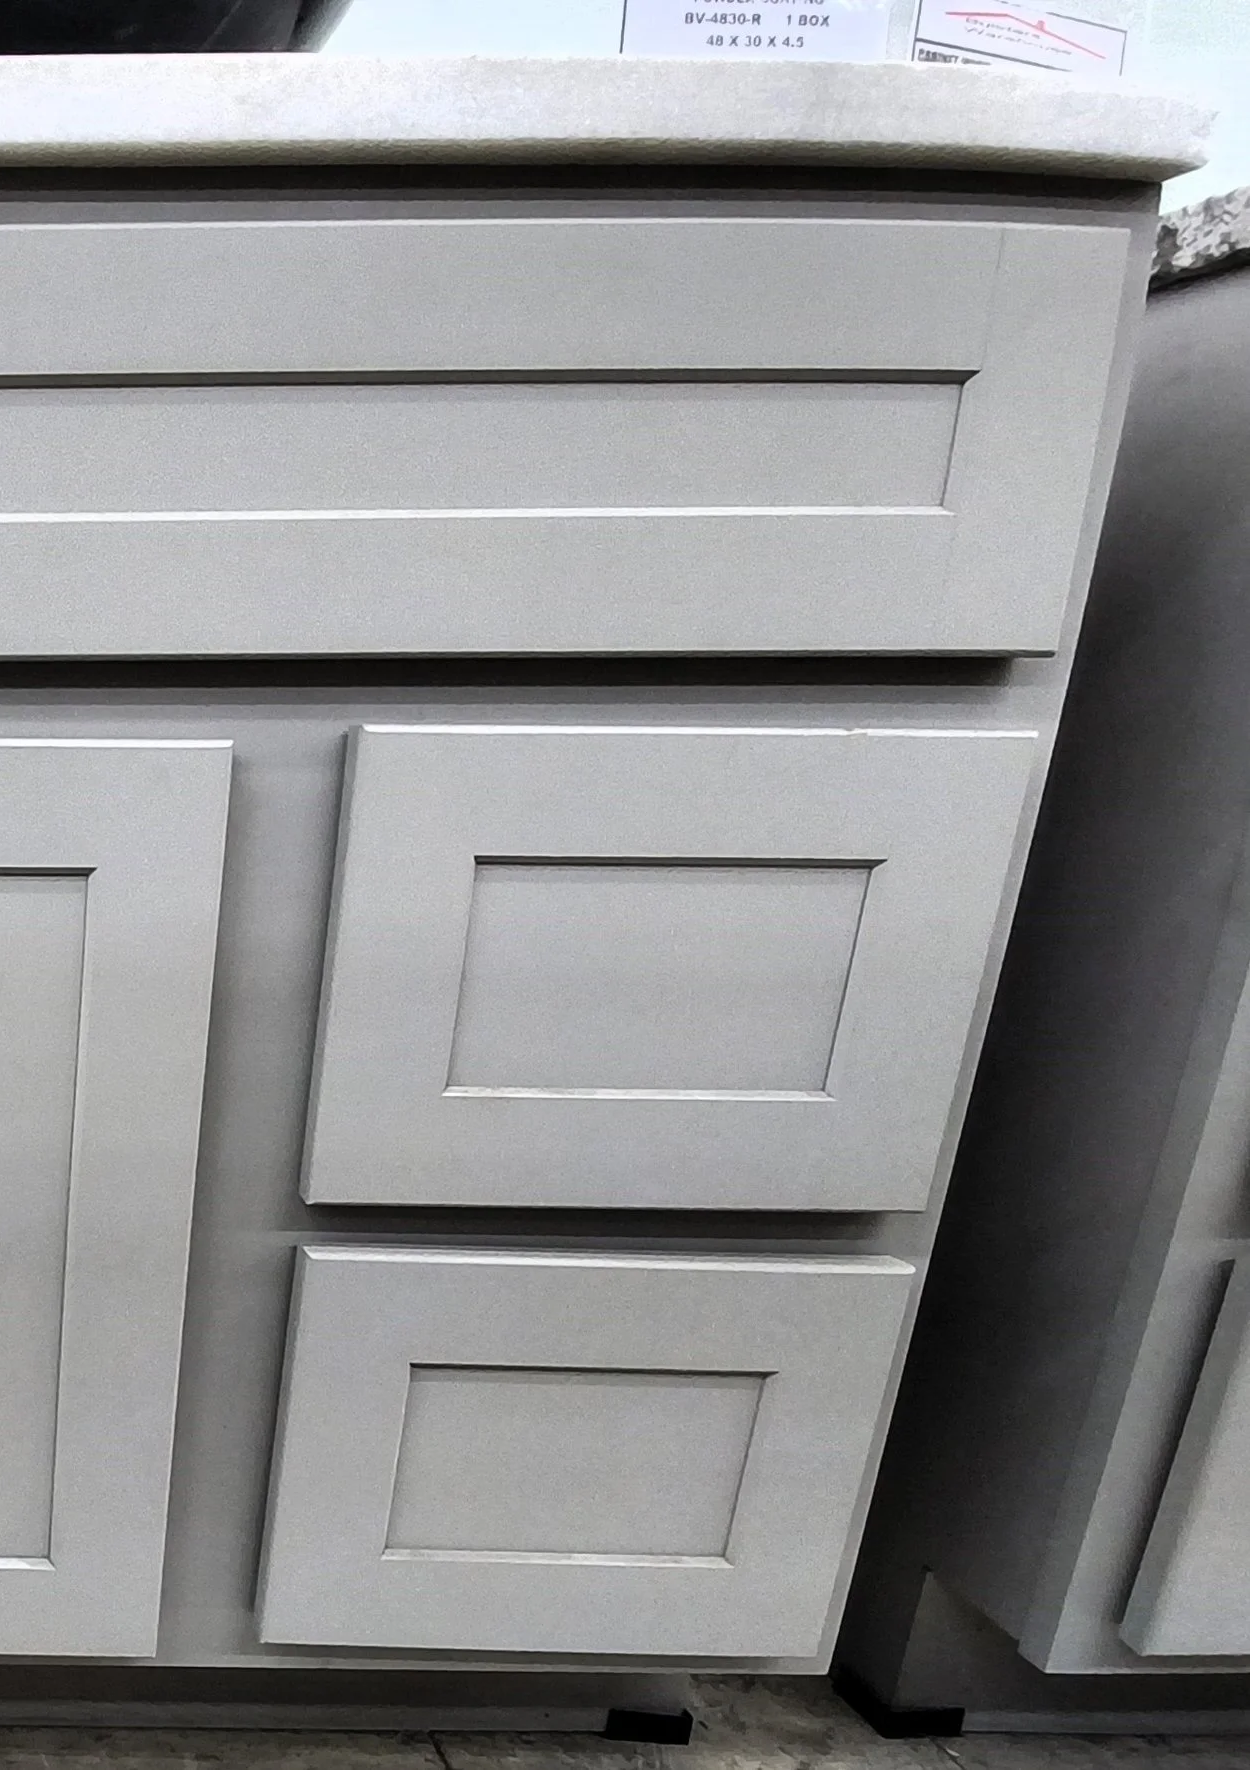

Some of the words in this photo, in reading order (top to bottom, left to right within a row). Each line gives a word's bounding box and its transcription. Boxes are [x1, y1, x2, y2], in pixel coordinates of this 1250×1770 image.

[684, 12, 762, 25] BV-4830-R
[786, 14, 792, 26] 1
[798, 14, 830, 27] BOX
[706, 34, 724, 47] 48
[729, 35, 739, 47] X
[745, 35, 762, 48] 30
[767, 35, 777, 48] X
[782, 36, 804, 48] 4.5
